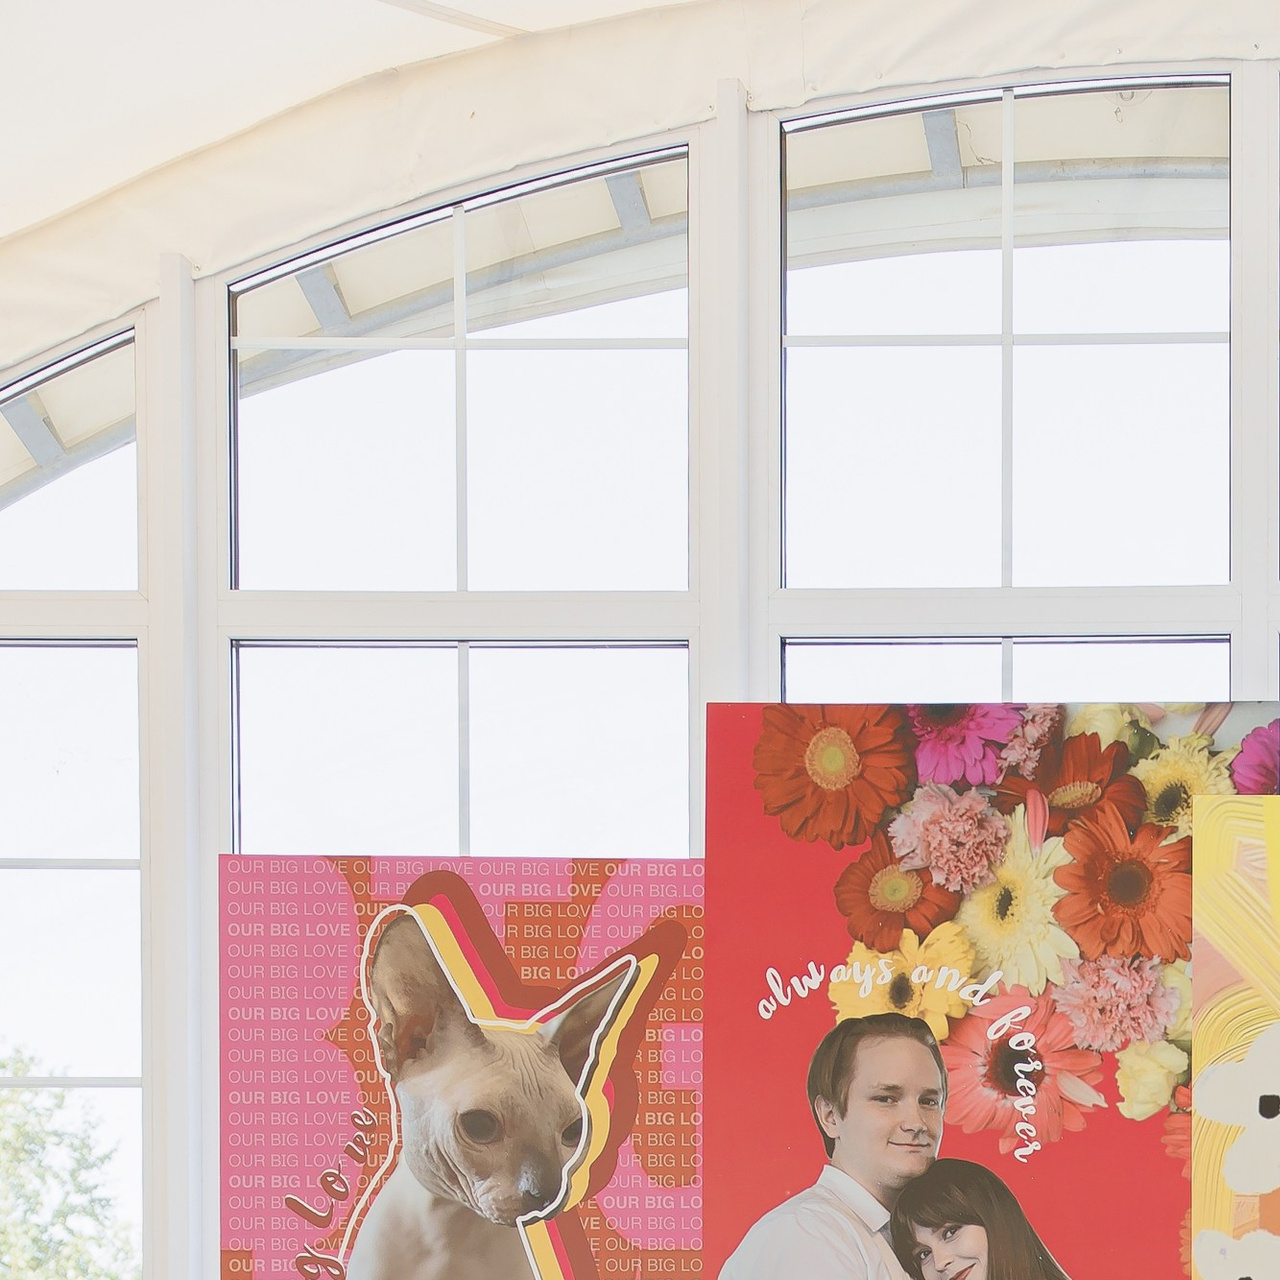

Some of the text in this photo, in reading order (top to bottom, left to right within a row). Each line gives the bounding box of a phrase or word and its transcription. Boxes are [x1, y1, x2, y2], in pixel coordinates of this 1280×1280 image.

[228, 861, 676, 876] OUR BIG LOVE OUR BIG OUR BIG LOVE OUR BIG
[228, 882, 677, 897] OUR BIG LOVE OUR OUR BIG LOVE OUR BIG
[228, 903, 677, 918] OUR BIG LOVE BIG LOVE OUR BIG
[228, 924, 350, 936] OUR BIG LOVE
[228, 945, 348, 957] OUR BIG LOVE
[228, 966, 348, 978] OUR BIG LOVE
[228, 987, 348, 999] OUR BIG LOVE
[228, 1008, 350, 1020] OUR BIG LOVE
[228, 1028, 348, 1041] OUR BIG LOVE
[228, 1049, 348, 1062] OUR BIG LOVE
[756, 958, 1041, 1163] always and forever
[228, 1070, 348, 1083] OUR BIG LOVE
[228, 1091, 350, 1104] OUR BIG LOVE
[228, 1112, 348, 1125] OUR BIG LOVE
[228, 1133, 348, 1146] OUR BIG LOVE
[228, 1154, 348, 1167] OUR BIG LOVE
[285, 1107, 377, 1228] Love
[228, 1175, 301, 1188] OUR BIG
[604, 1197, 675, 1209] OUR BIG
[228, 1217, 676, 1230] OUR BIG OUR BIG
[228, 1238, 676, 1251] OUR BIG OUR BIG
[606, 1259, 676, 1272] OUR BIG
